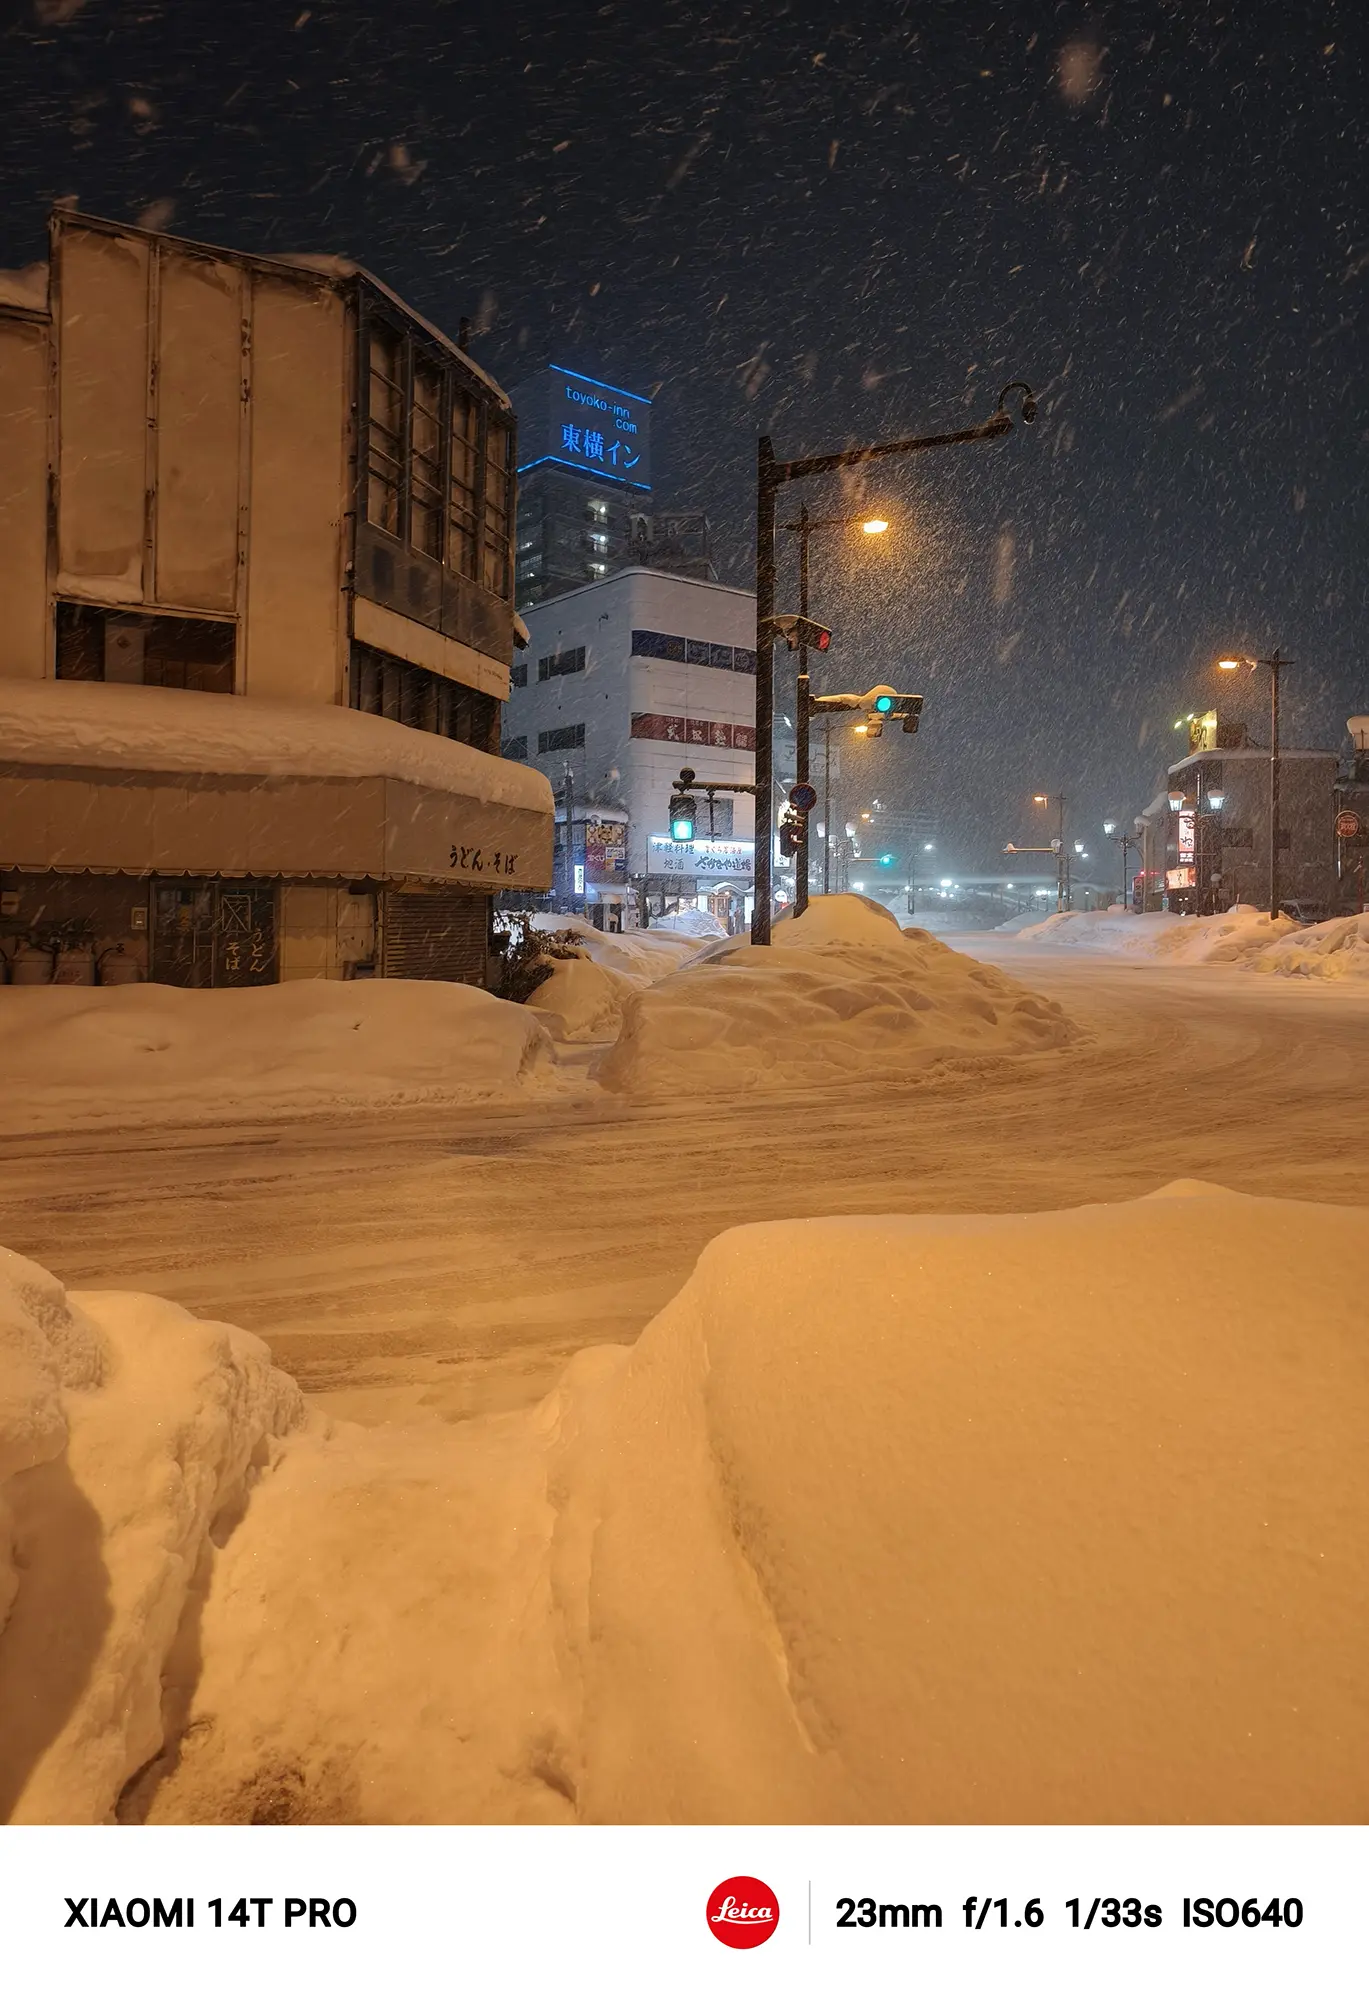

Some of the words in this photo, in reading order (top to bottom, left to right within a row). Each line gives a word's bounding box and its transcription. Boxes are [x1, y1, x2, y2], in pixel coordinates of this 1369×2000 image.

[566, 385, 630, 419] toyoko-inn
[560, 423, 641, 469] 東横イン
[663, 857, 685, 870] 地酒
[694, 855, 752, 871] さかなや道場
[226, 941, 241, 971] そば
[249, 928, 265, 973] うどん
